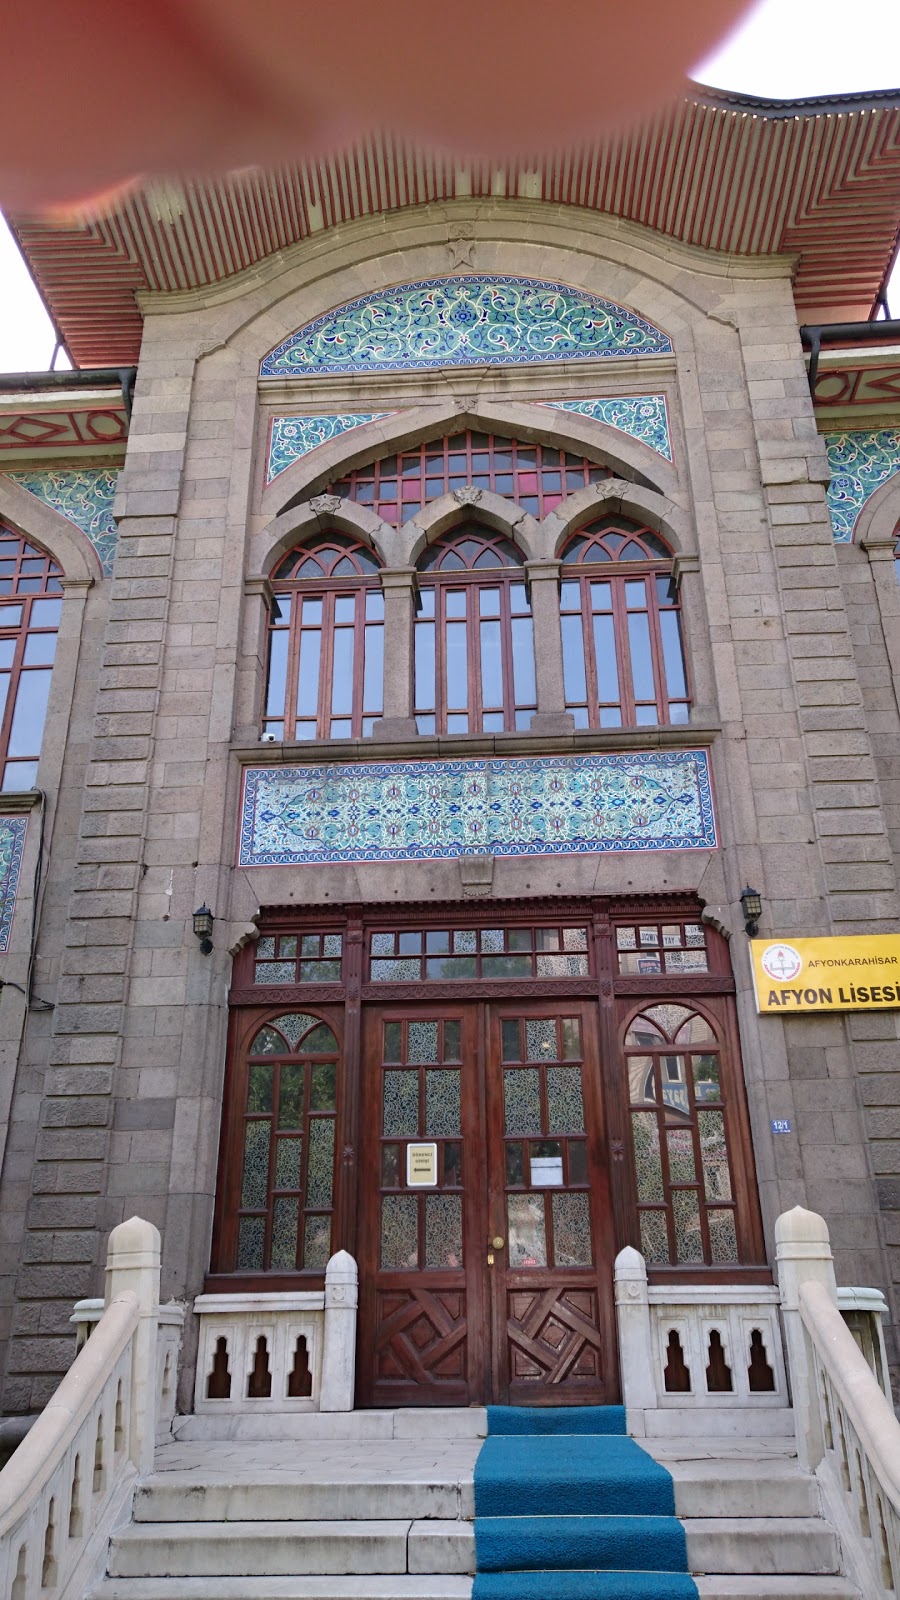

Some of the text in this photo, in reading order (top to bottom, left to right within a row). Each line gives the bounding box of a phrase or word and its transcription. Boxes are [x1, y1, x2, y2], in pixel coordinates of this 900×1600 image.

[808, 956, 898, 968] AFYONKARAHİSAR
[768, 981, 900, 1006] AFYON LİSESİ
